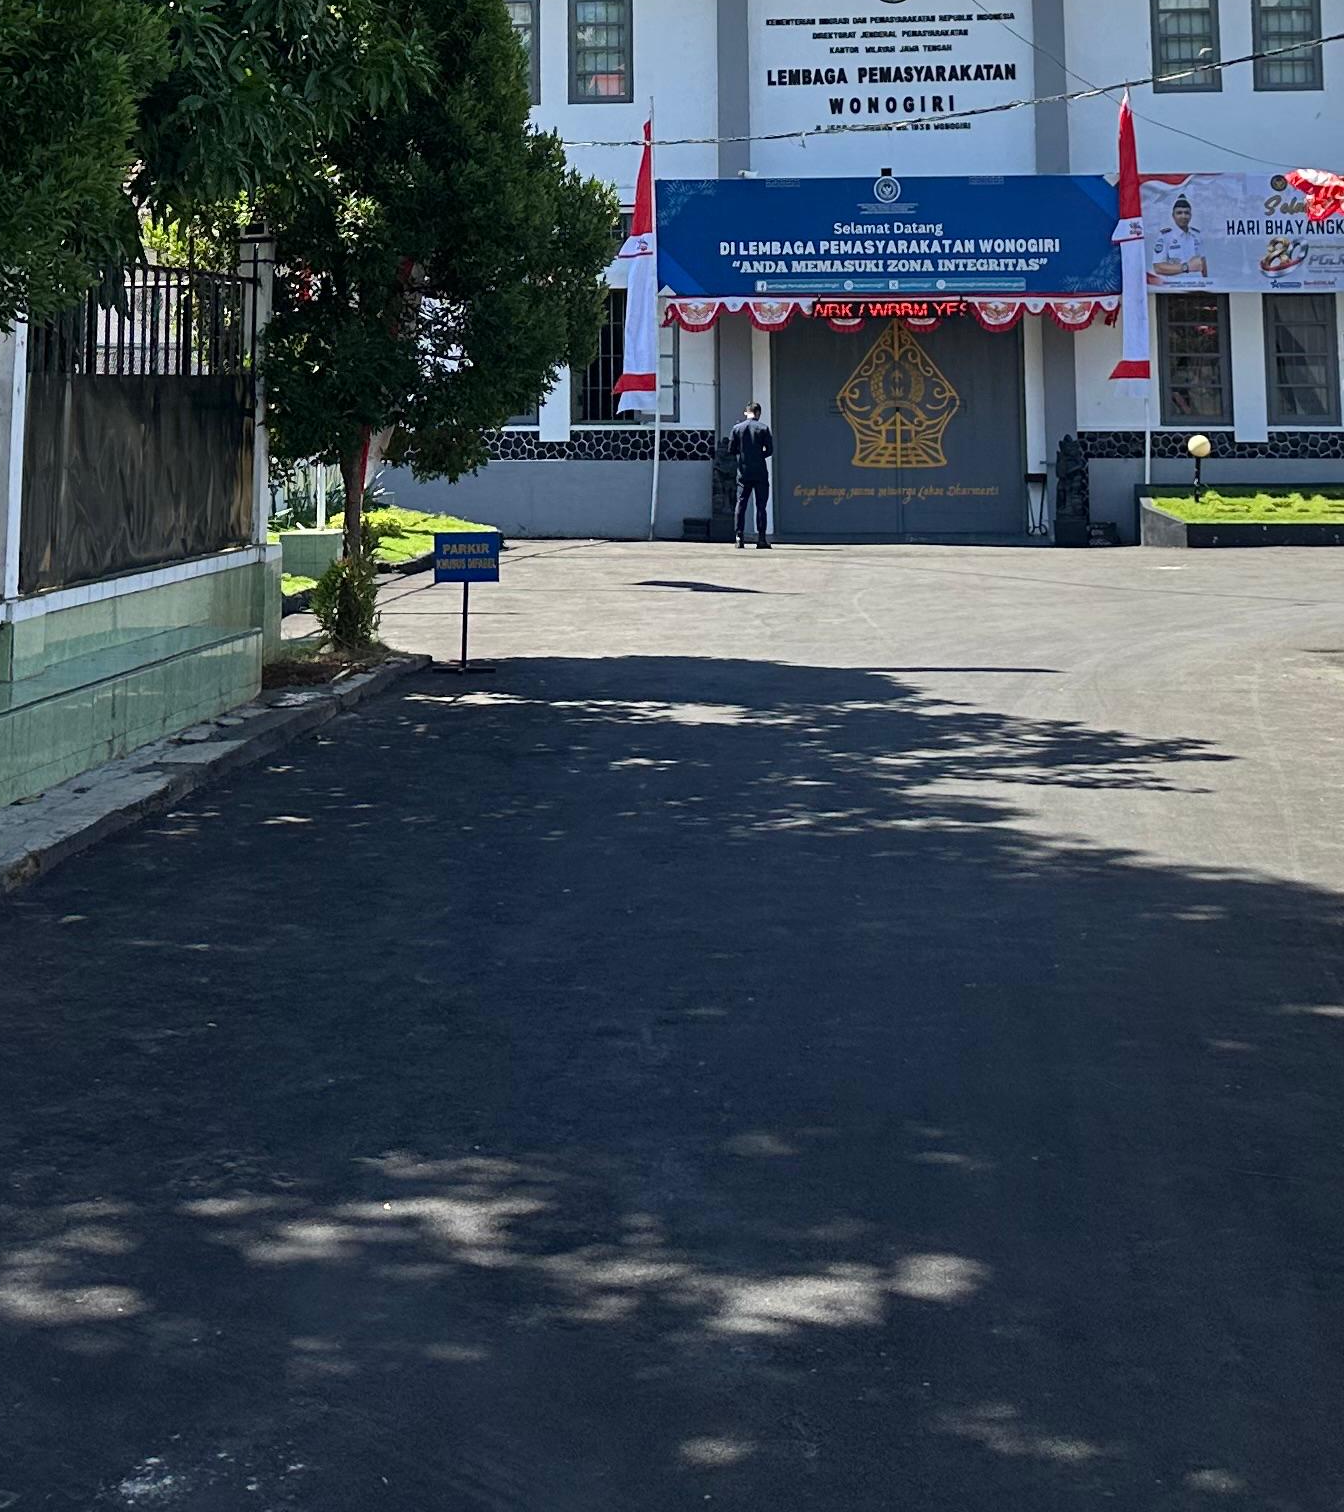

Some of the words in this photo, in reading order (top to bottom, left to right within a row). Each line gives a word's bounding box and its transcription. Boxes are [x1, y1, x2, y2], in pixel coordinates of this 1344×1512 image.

[767, 68, 848, 86] LEMBAGA
[858, 64, 1016, 84] PEMASYARAKATAN
[829, 95, 954, 114] WONOGIRI
[834, 223, 890, 235] Selamat
[894, 222, 943, 237] Datang
[1227, 219, 1260, 235] HARI
[720, 242, 735, 256] DI
[739, 241, 814, 255] LEMBAGA
[820, 240, 975, 254] PEMASYARAKATAN
[979, 239, 1060, 253] WONOGIRI
[791, 259, 884, 273] MEMASUKI
[887, 259, 934, 272] ZONA
[442, 543, 489, 554] PARKIR
